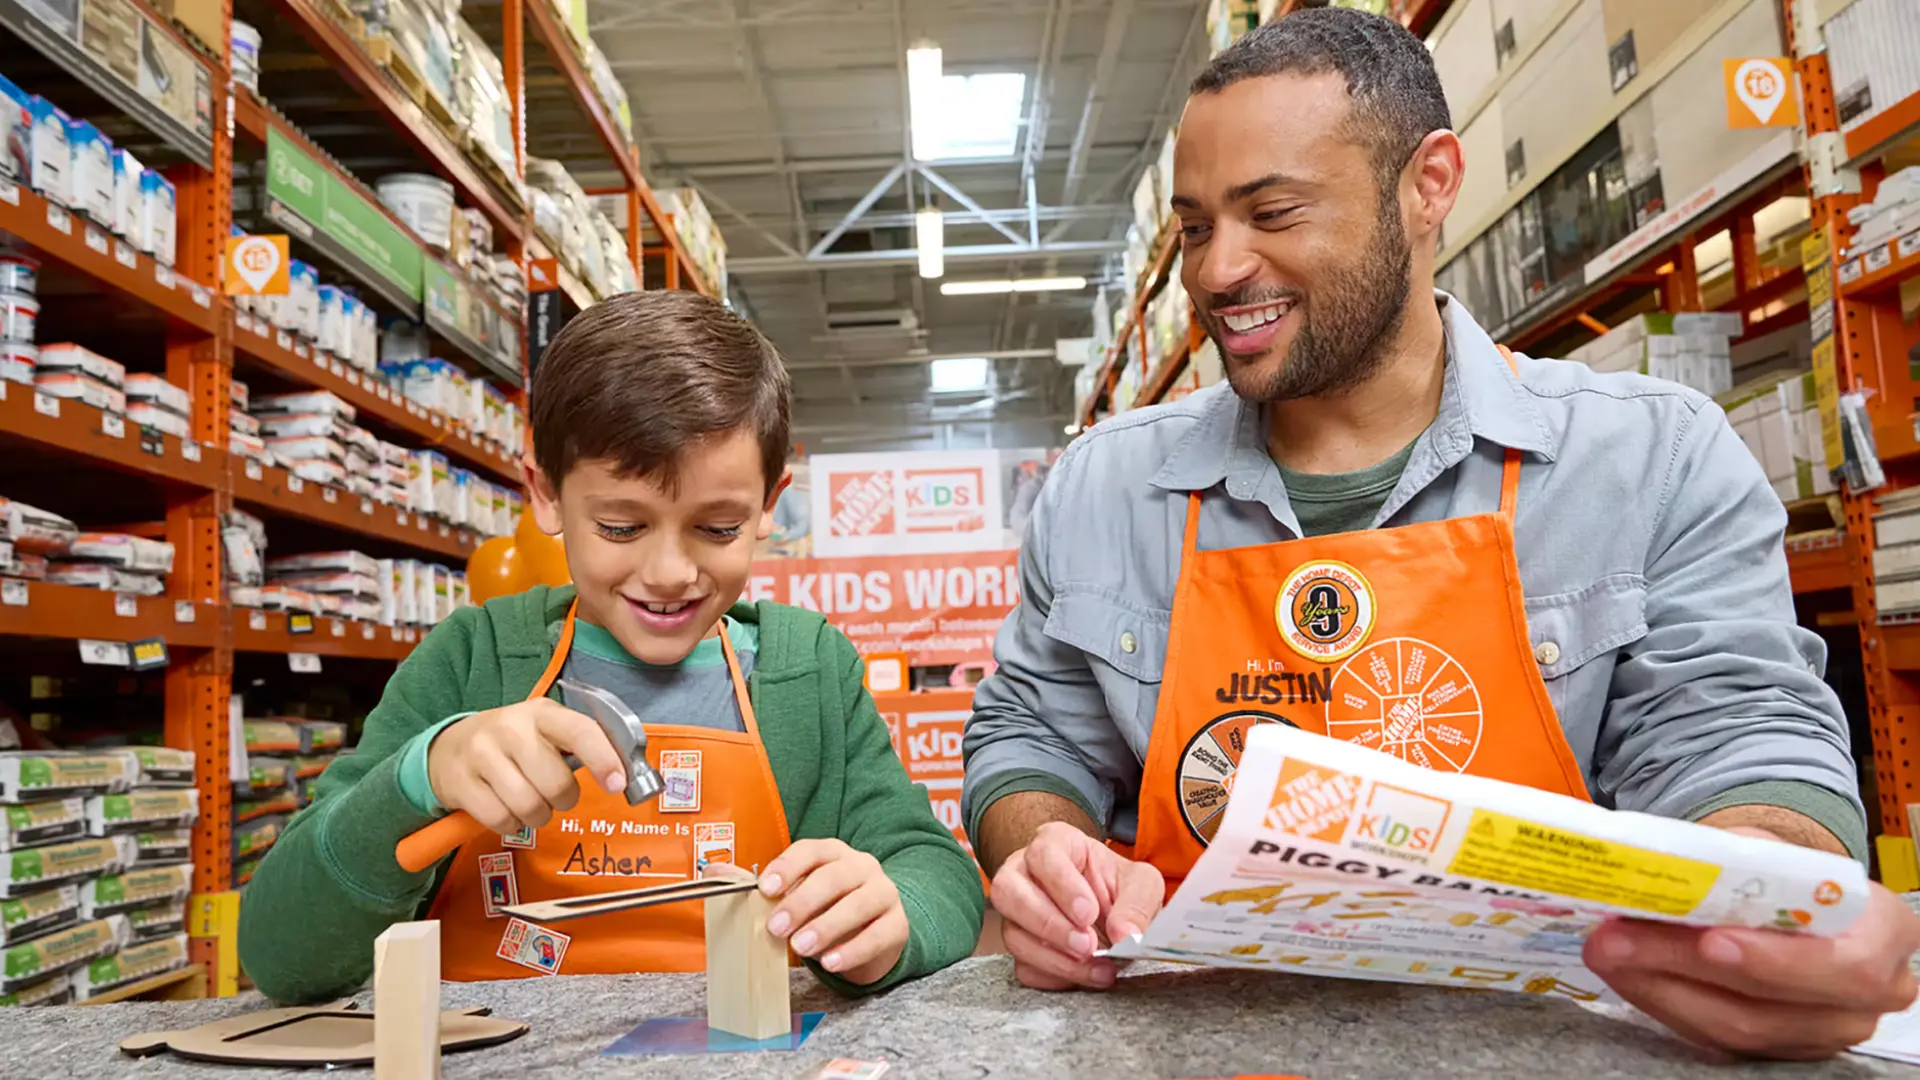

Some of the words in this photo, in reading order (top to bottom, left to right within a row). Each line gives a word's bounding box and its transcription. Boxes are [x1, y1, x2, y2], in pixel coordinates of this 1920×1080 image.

[905, 482, 970, 507] KIDS
[789, 571, 893, 614] KIDS
[1287, 580, 1303, 597] THE
[1301, 568, 1331, 583] HOME
[1332, 569, 1362, 592] DEPOT
[1299, 601, 1350, 627] Years
[1308, 584, 1341, 638] 9
[1291, 631, 1331, 654] SERVICE
[1334, 625, 1363, 652] AWARD
[1247, 659, 1265, 673] Hi,
[1268, 659, 1285, 671] I'm
[1215, 666, 1332, 705] JUSTIN
[1266, 775, 1357, 831] HOME
[561, 819, 584, 835] Hi,
[590, 819, 616, 836] My
[621, 820, 670, 835] Name
[675, 822, 690, 835] Is
[1356, 813, 1432, 850] KIDS
[563, 841, 652, 876] Asher
[1248, 839, 1406, 880] PIGGY
